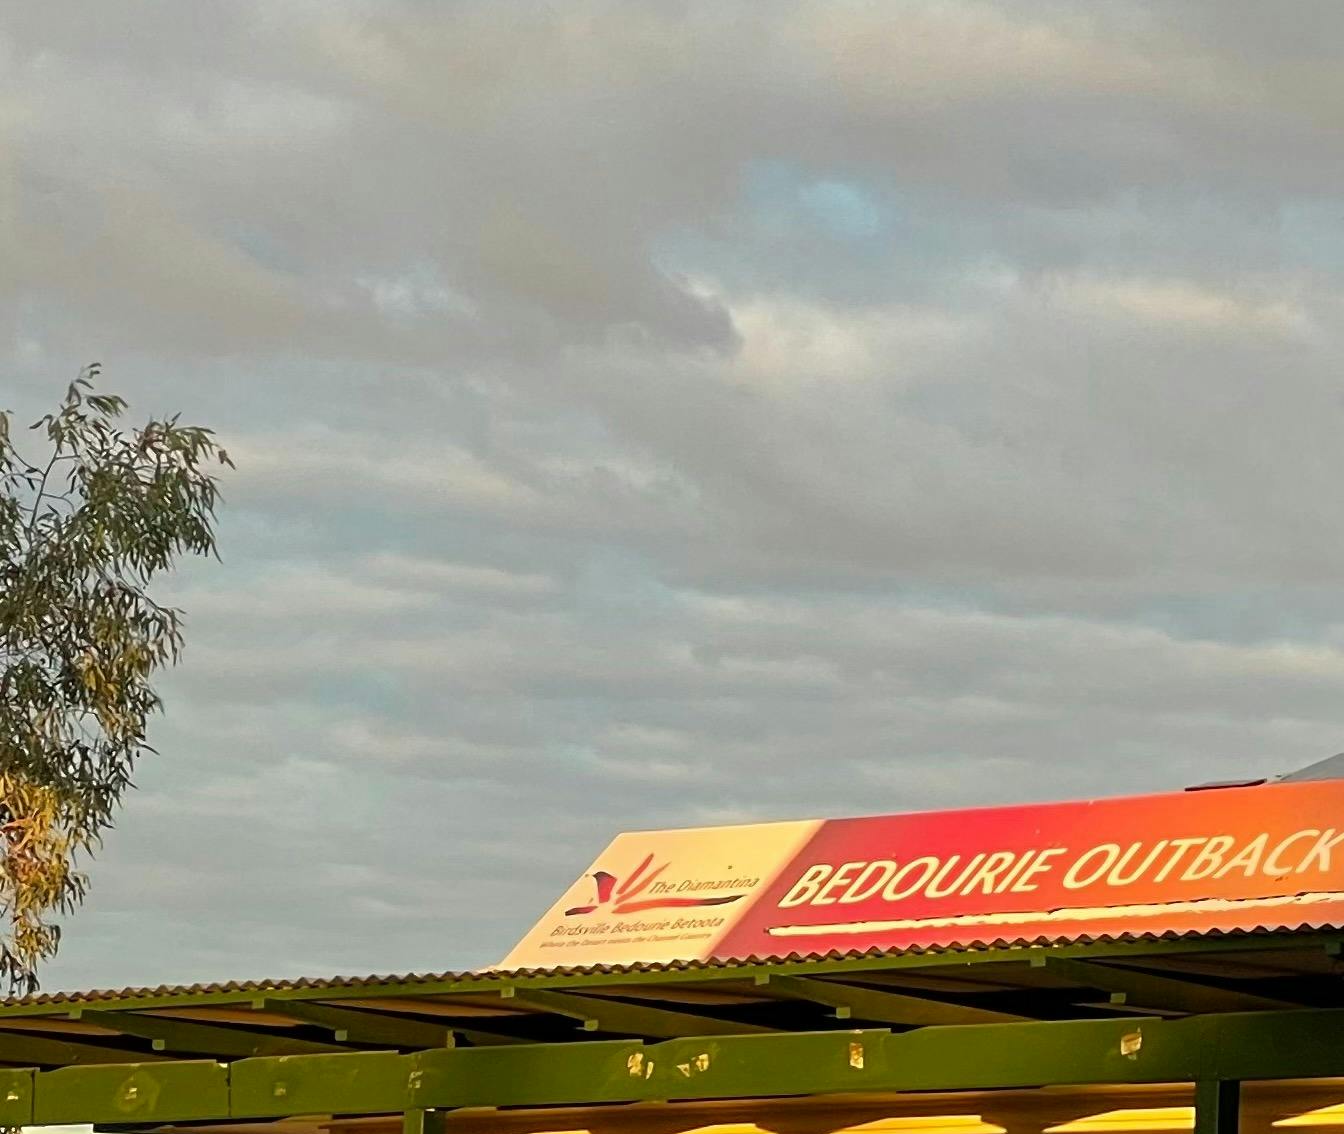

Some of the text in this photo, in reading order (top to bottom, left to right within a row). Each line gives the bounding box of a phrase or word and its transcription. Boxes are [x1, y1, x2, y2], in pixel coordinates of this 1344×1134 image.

[649, 875, 760, 894] The Diamantina
[778, 847, 1067, 908] BEDOURIE
